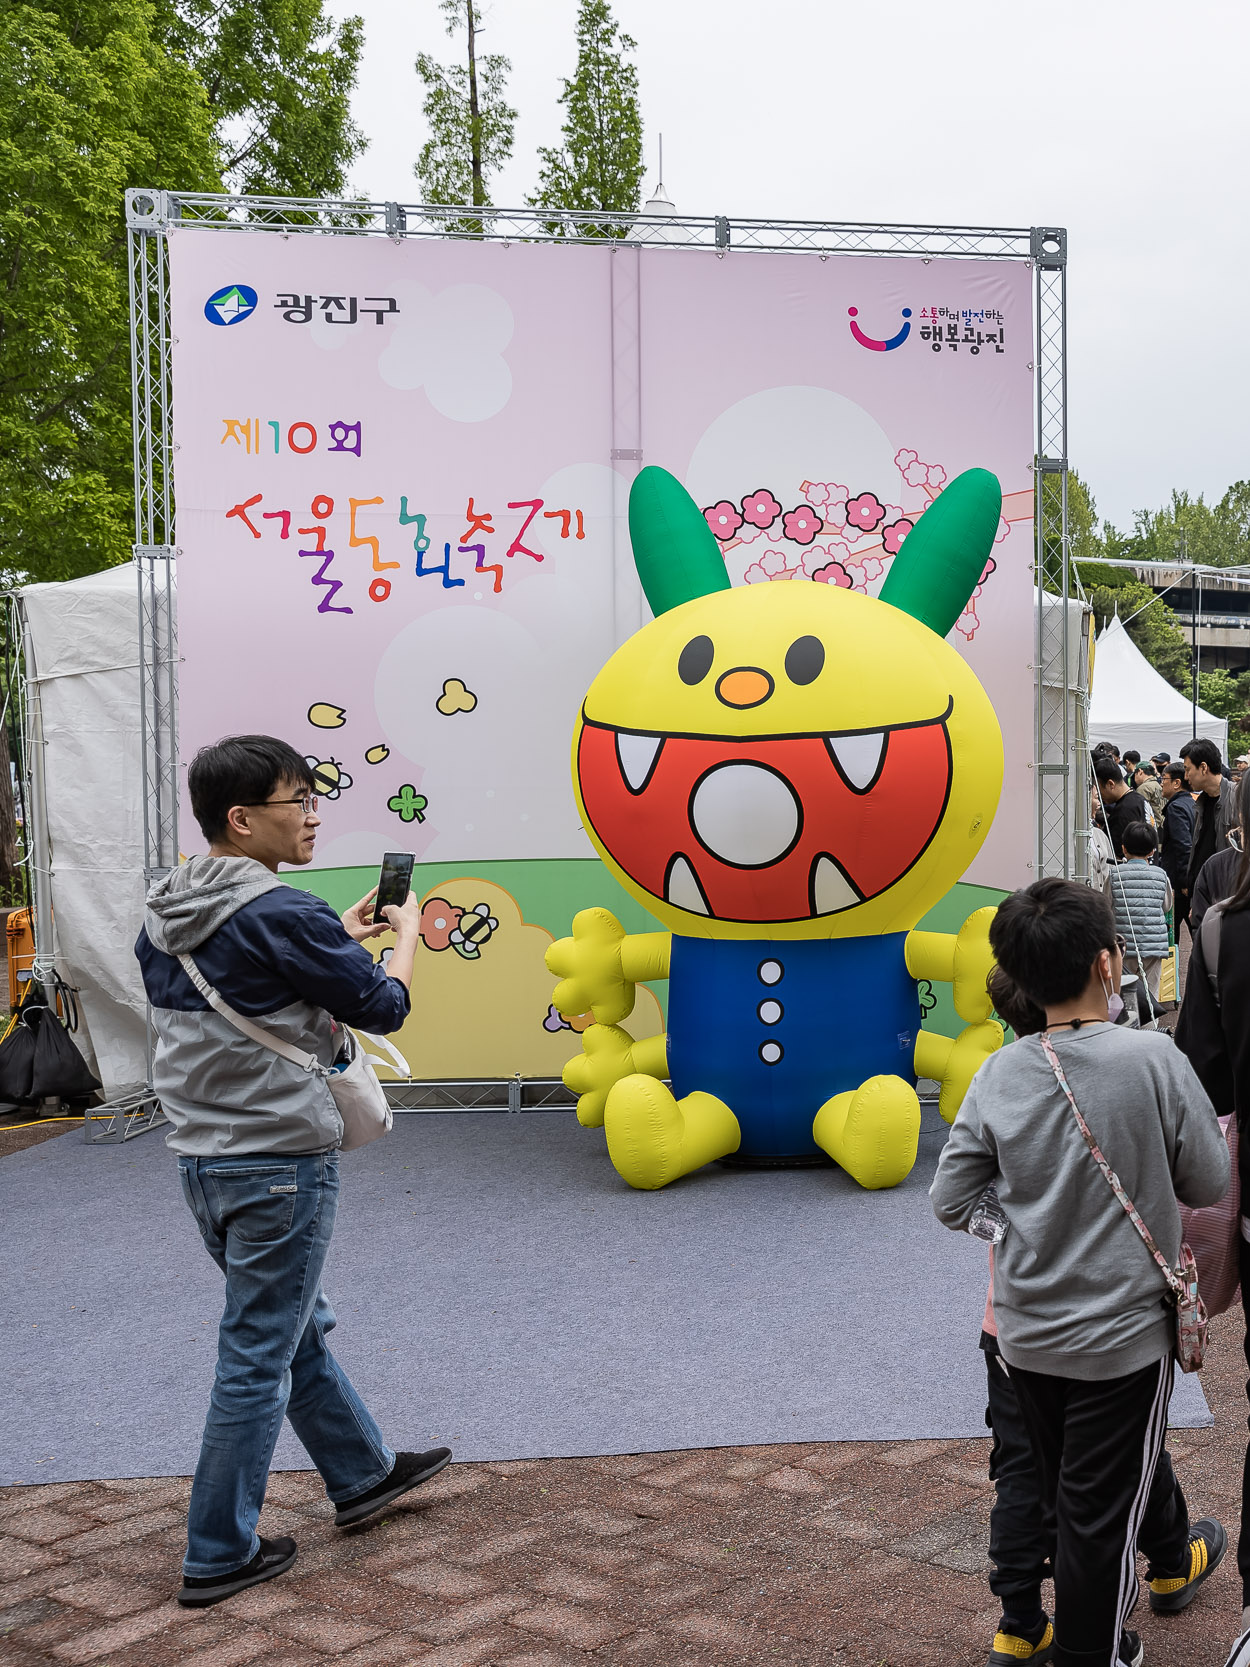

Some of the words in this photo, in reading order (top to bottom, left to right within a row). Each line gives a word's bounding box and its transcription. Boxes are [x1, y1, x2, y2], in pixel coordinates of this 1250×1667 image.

[274, 293, 400, 325] 광진구
[919, 307, 959, 325] 소통하며
[961, 309, 1004, 326] 발전하는
[919, 323, 1005, 355] 행복광진
[220, 418, 362, 457] 제10회
[225, 493, 586, 615] 서울동화축제
